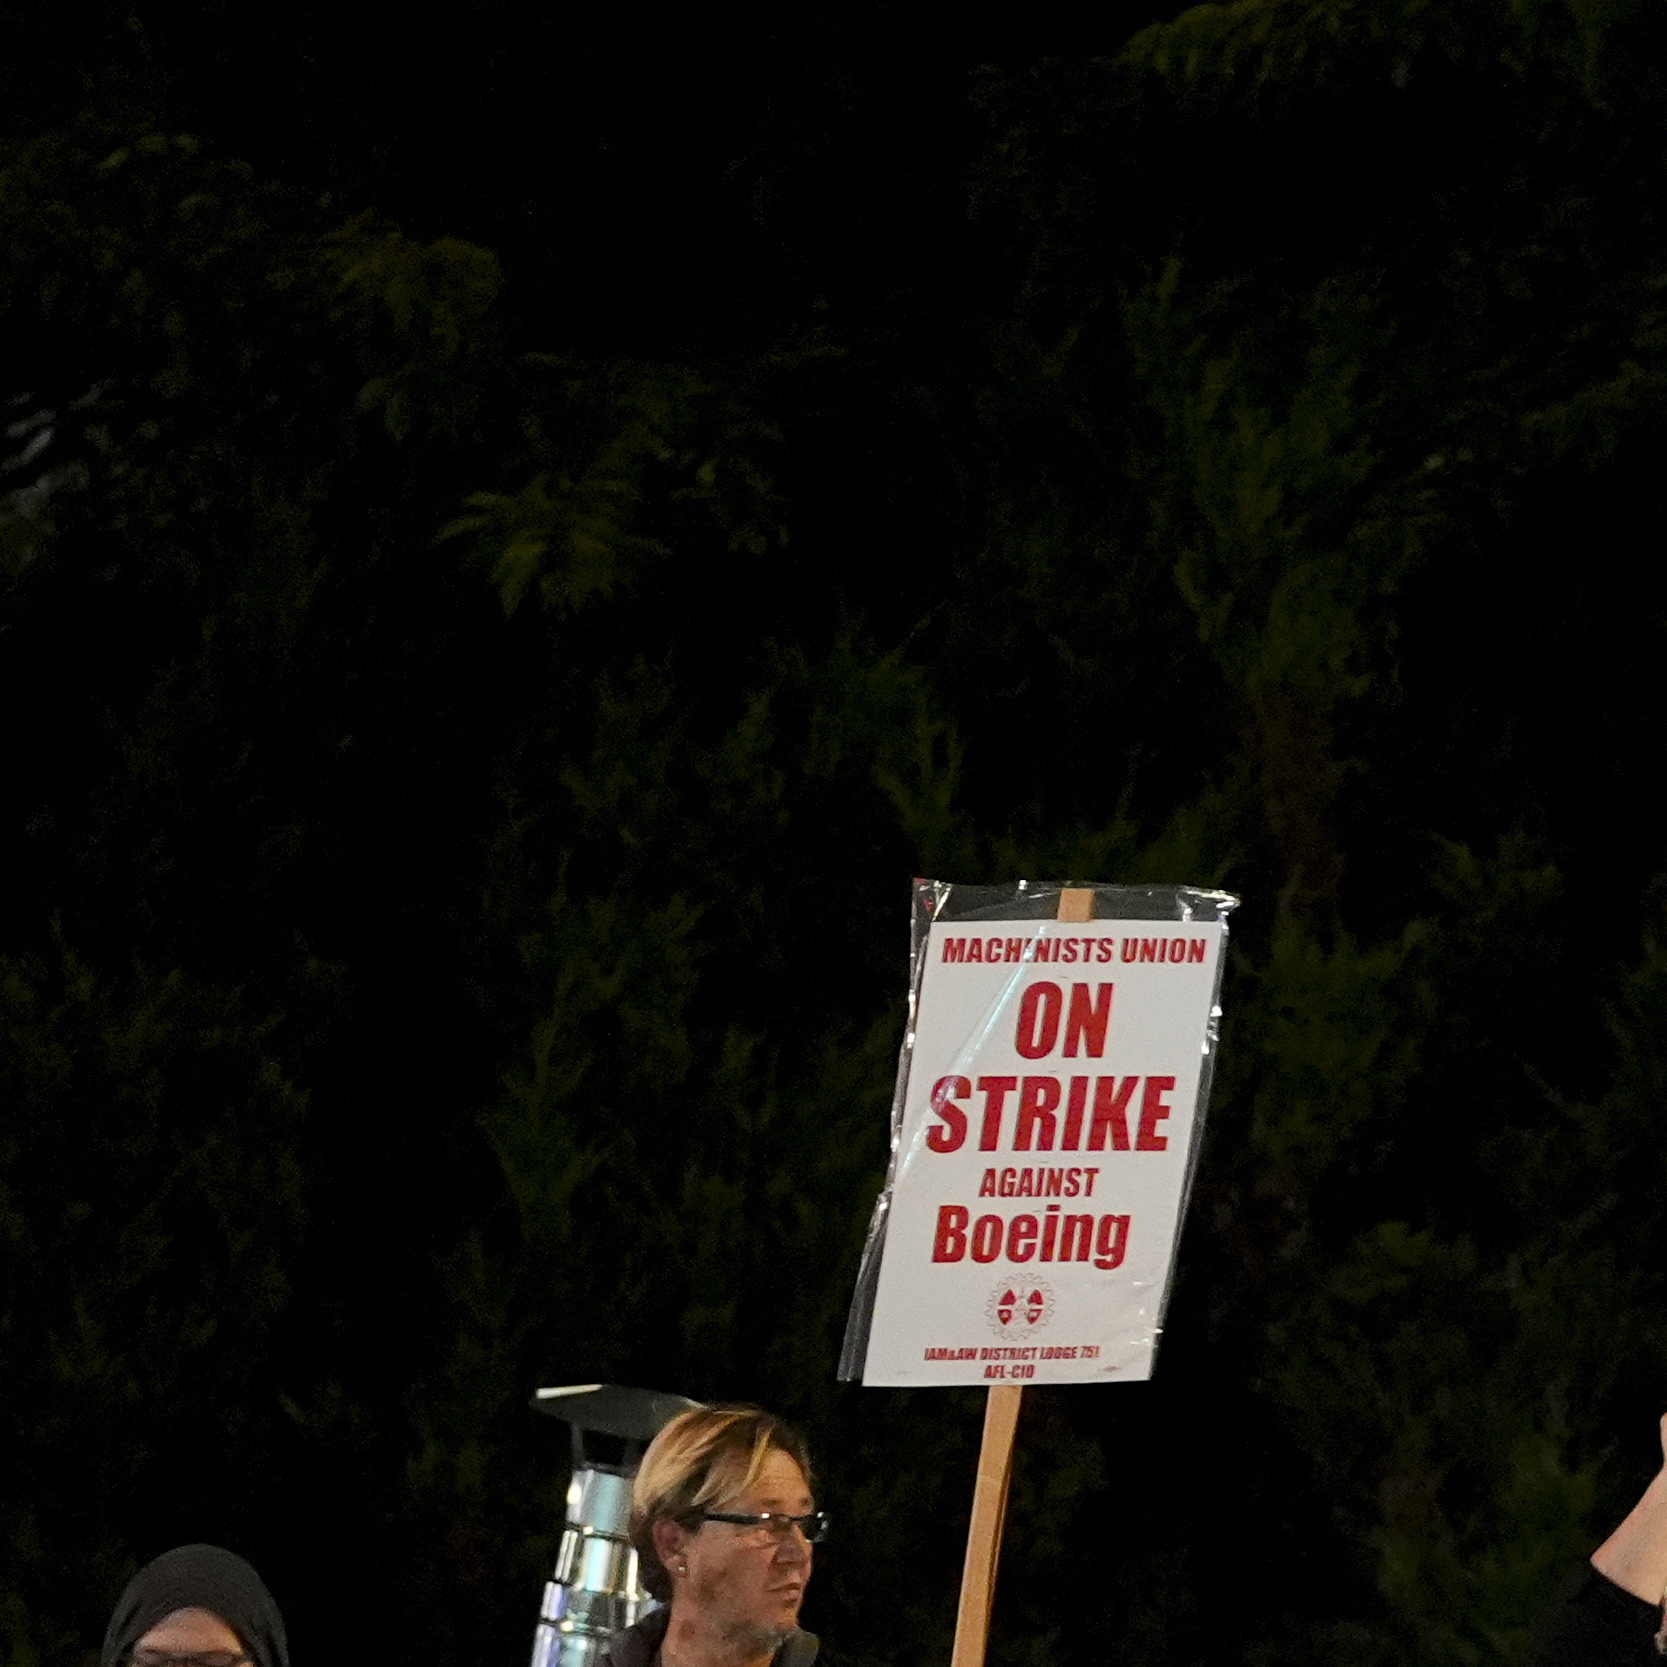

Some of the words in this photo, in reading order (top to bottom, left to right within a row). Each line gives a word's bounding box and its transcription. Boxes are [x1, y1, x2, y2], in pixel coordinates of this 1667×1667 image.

[942, 936, 1113, 964] MACHINISTS
[1121, 937, 1207, 964] UNION
[1015, 980, 1115, 1060] ON
[925, 1074, 1177, 1154] STRIKE
[978, 1167, 1100, 1198] AGAINST
[931, 1204, 1132, 1270] Boeing
[979, 1346, 1038, 1361] DISTRICT
[983, 1364, 1036, 1379] AFL-CIO
